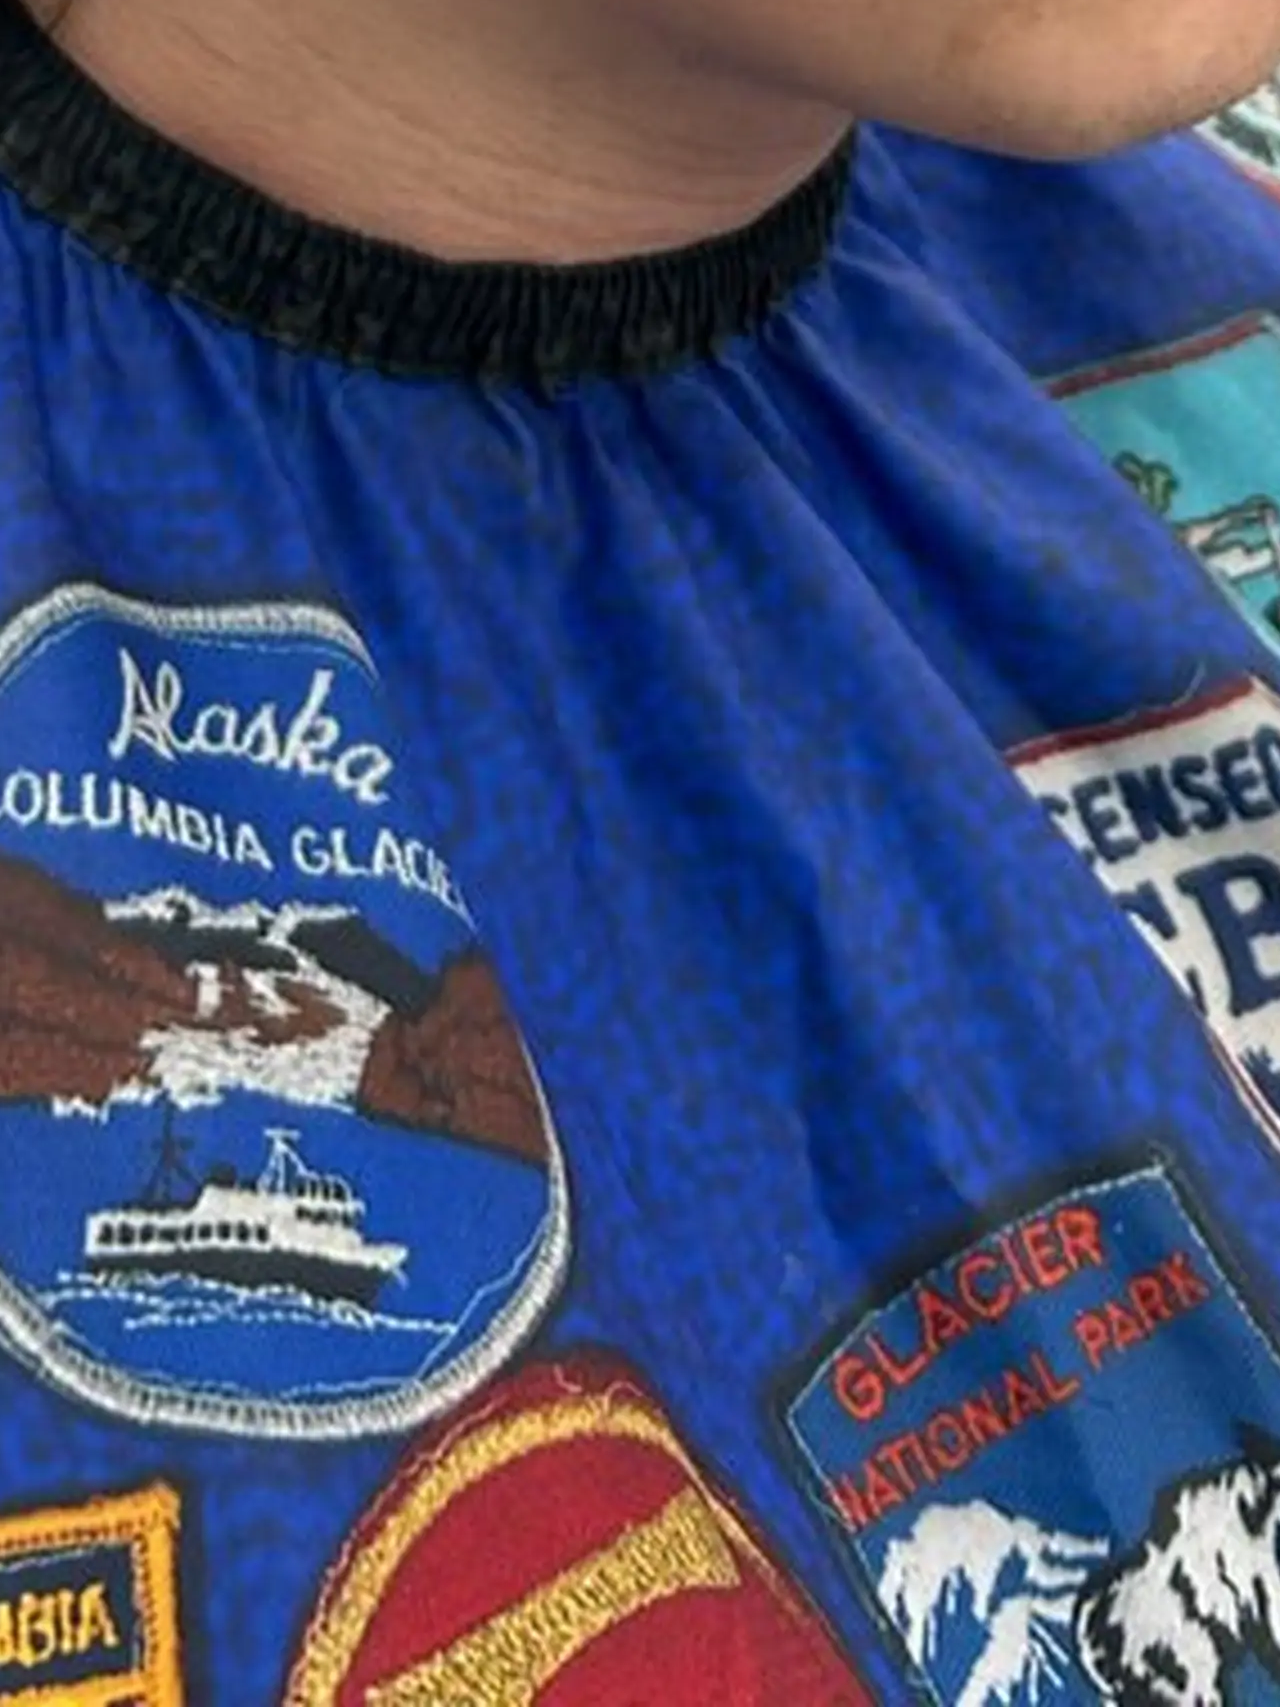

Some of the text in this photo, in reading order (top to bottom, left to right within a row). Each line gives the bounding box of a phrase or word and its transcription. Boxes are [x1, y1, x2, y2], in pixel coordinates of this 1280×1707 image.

[108, 646, 395, 805] Alaska
[827, 1250, 1212, 1535] NATIONAL PARK
[833, 1204, 1103, 1423] GLACIER
